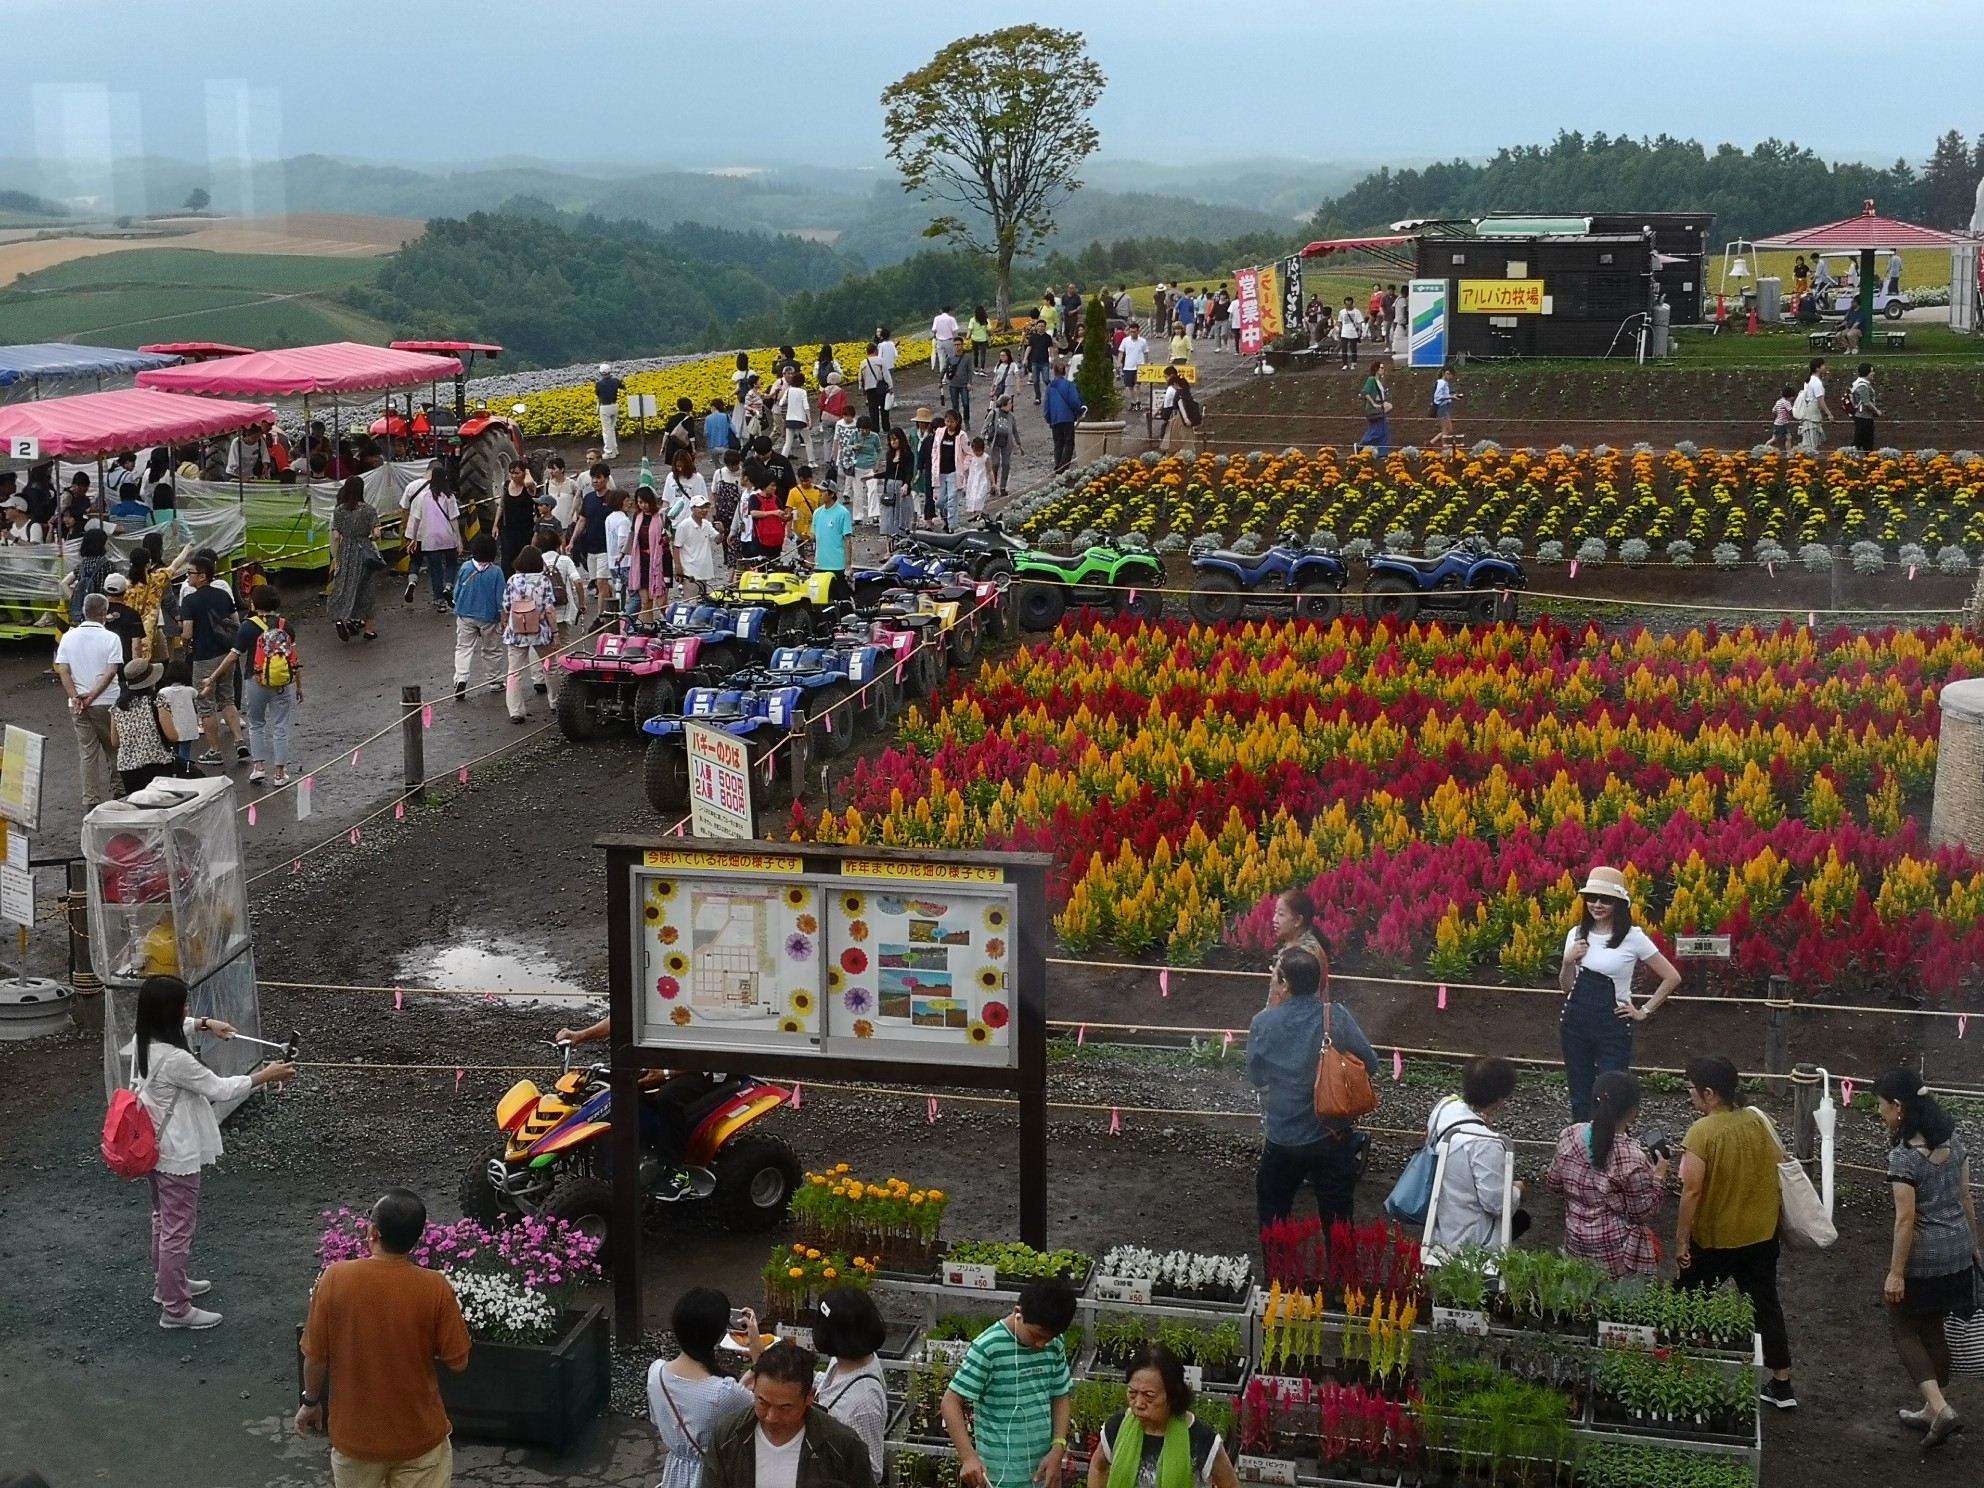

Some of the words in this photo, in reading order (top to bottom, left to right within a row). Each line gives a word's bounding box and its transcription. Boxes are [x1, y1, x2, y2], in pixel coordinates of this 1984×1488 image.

[1462, 287, 1540, 306] アルパカ牧場
[1239, 274, 1260, 348] 営業中
[19, 441, 32, 456] 2
[693, 732, 741, 769] バギーのりば
[648, 850, 798, 871] 今咲いている花畑の様子です
[845, 860, 999, 881] 昨年までの花畑の様子です
